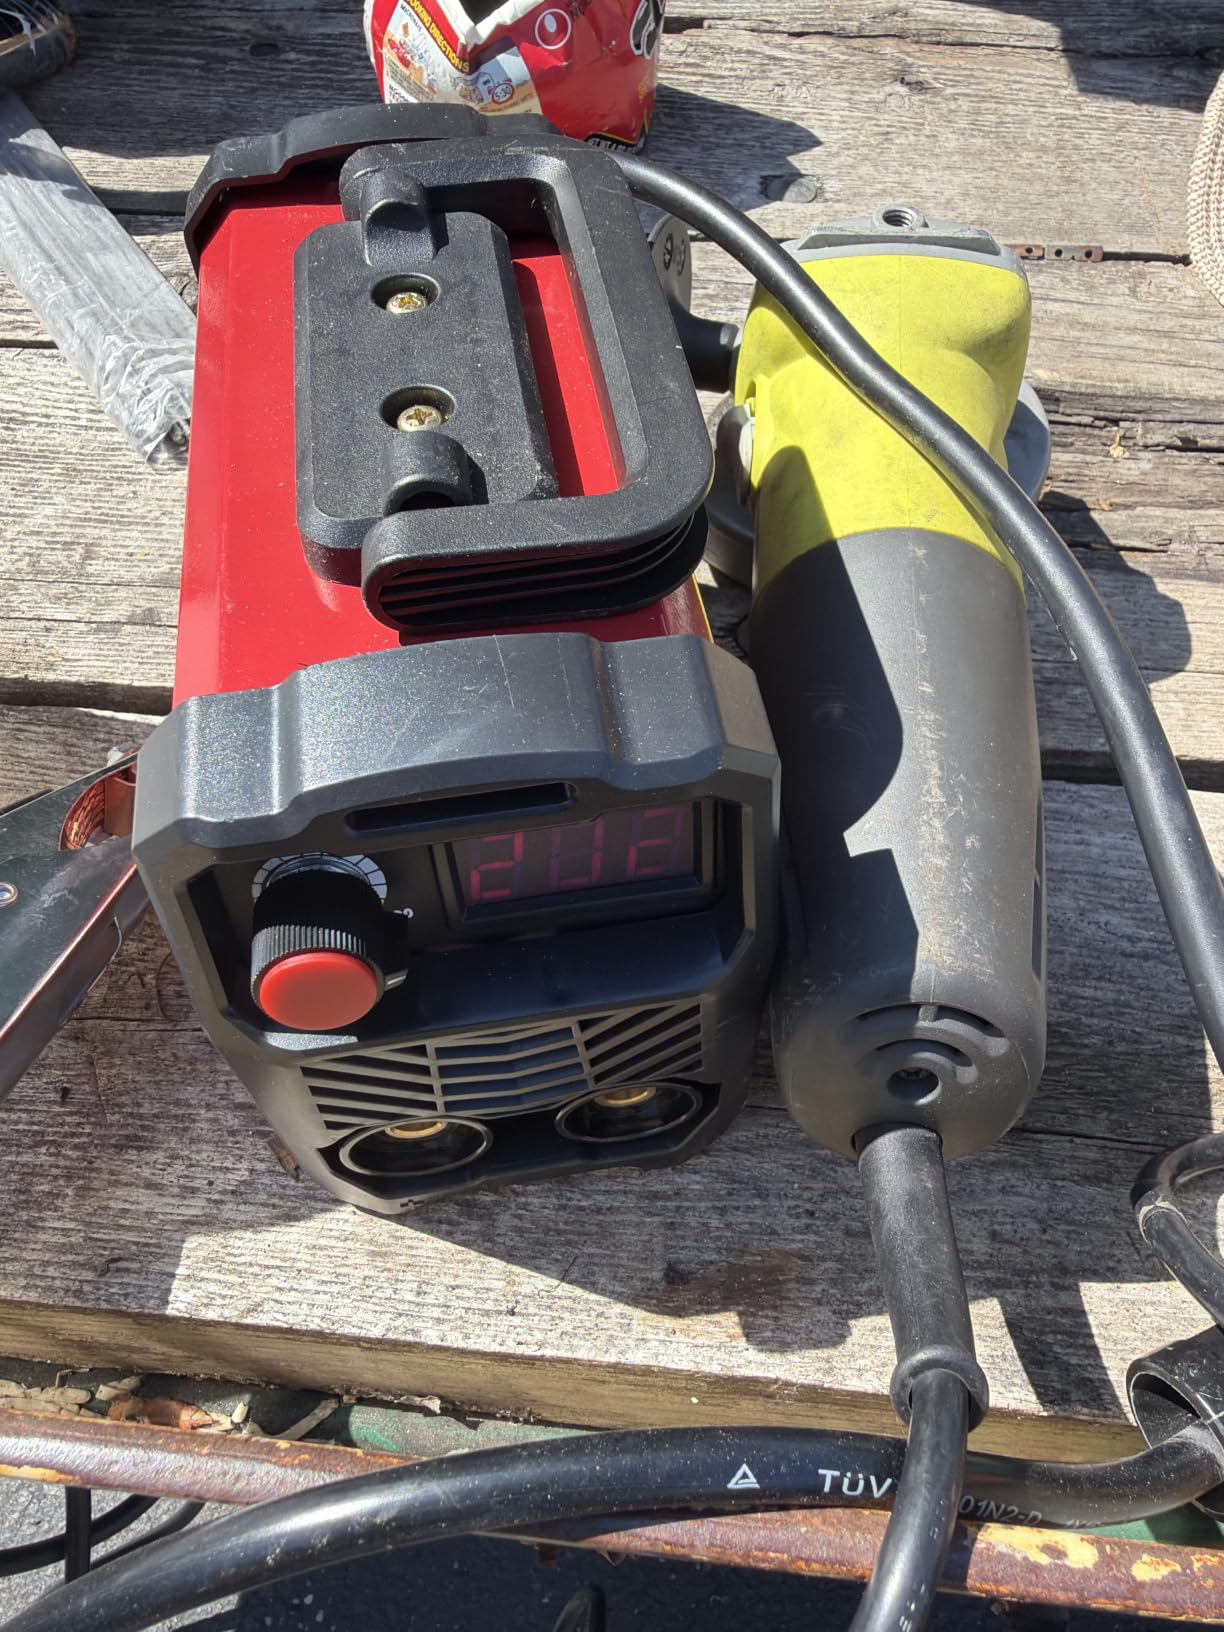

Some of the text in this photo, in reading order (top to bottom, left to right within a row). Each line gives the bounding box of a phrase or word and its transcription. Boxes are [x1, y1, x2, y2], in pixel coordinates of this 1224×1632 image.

[404, 0, 432, 29] OOKING
[429, 22, 470, 72] DIRECTIONS
[494, 84, 512, 101] 5:30
[818, 1468, 892, 1498] TÜV
